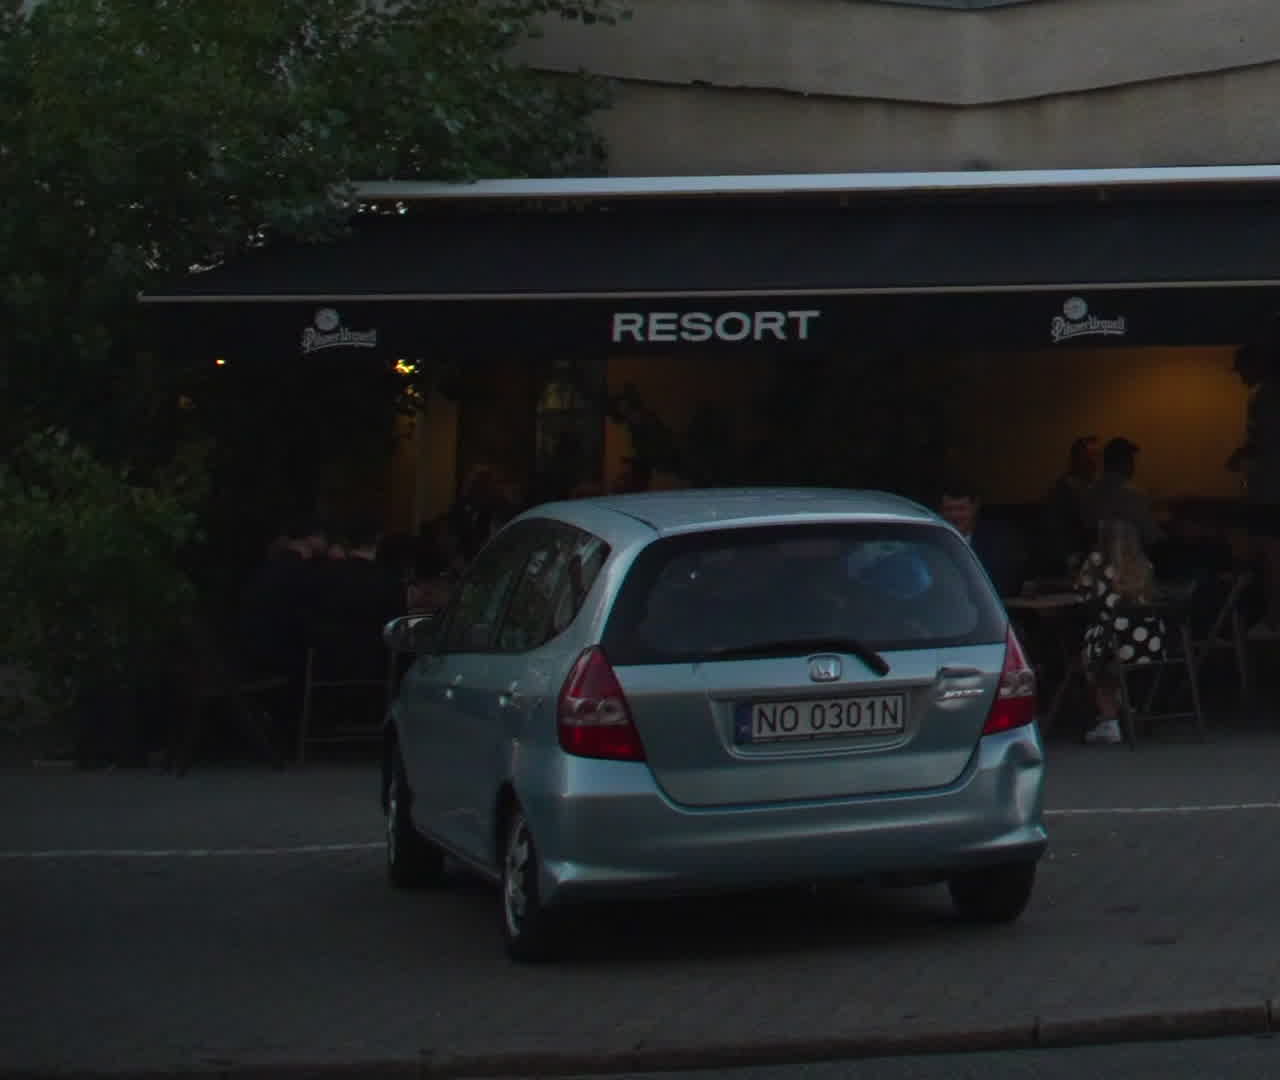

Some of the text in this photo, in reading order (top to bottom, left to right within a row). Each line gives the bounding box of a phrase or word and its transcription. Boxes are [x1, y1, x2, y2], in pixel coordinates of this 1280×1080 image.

[612, 309, 821, 343] RESORT
[756, 699, 899, 734] NO 0301N
